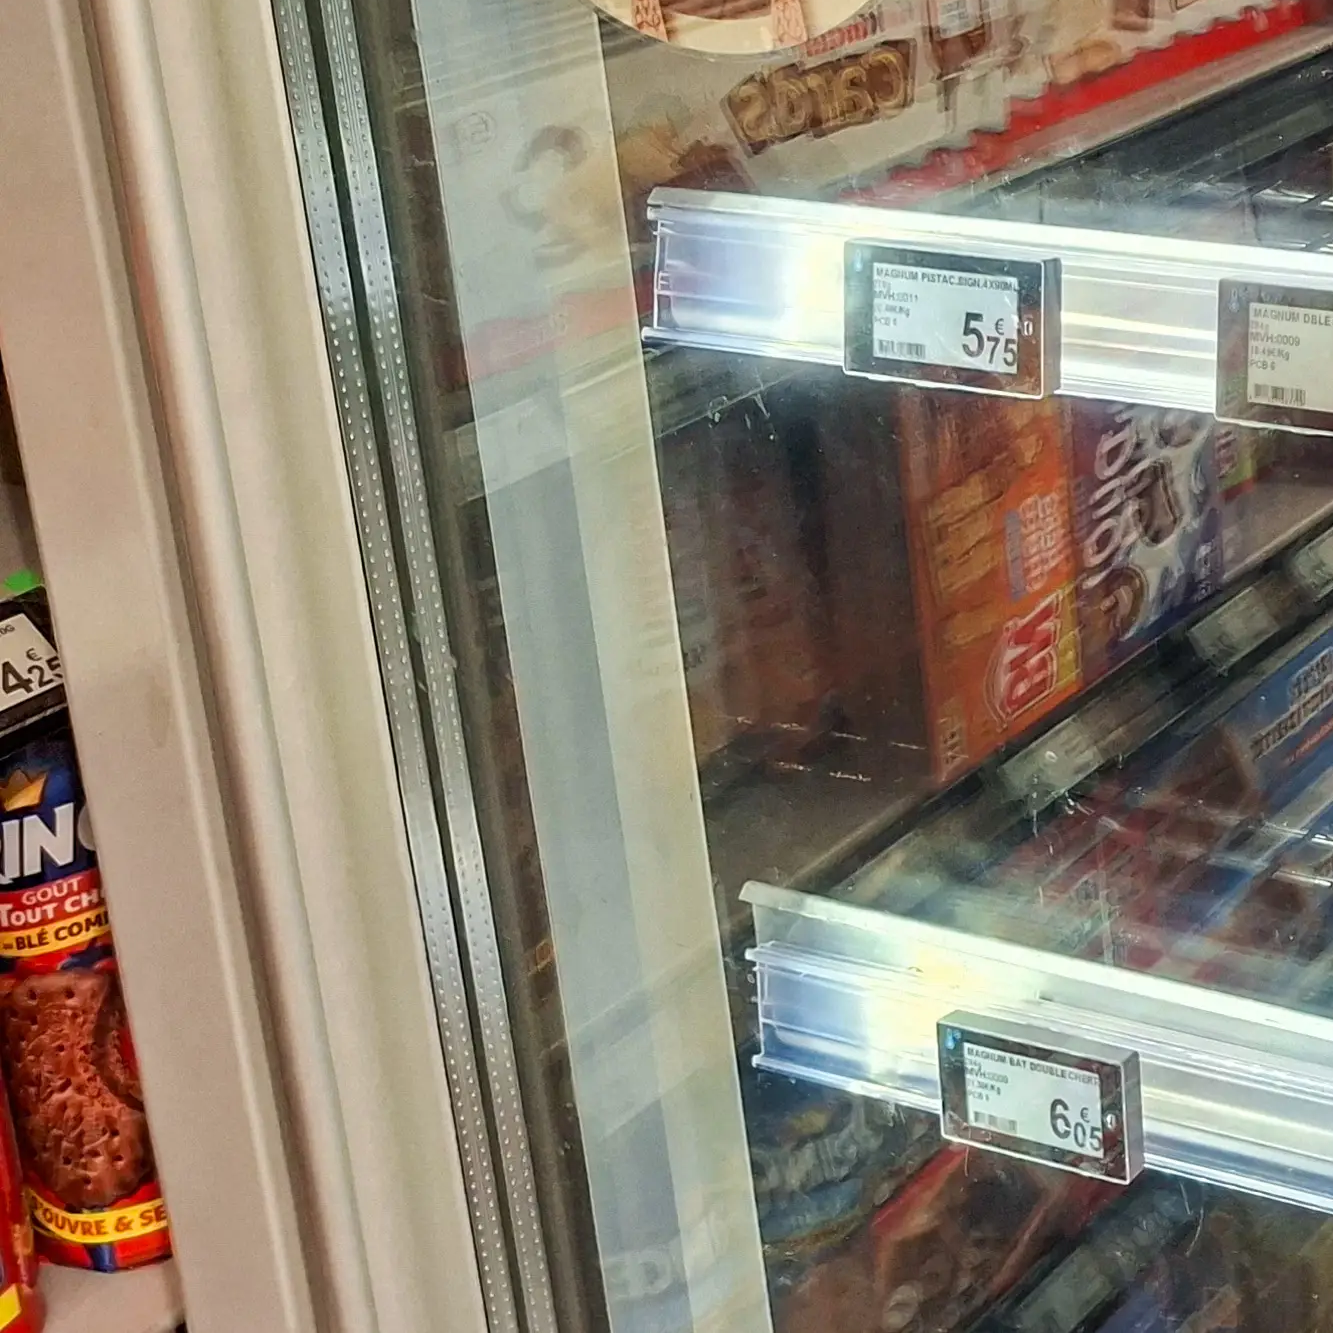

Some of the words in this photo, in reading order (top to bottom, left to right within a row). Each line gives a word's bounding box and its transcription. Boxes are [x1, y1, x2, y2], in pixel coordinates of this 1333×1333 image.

[1254, 307, 1301, 323] MAGNUM
[1303, 313, 1331, 327] DBLE
[962, 311, 984, 358] 5
[987, 336, 1018, 367] 75
[2, 661, 34, 695] 4
[64, 888, 103, 914] CH
[54, 910, 109, 942] COM
[1051, 1099, 1072, 1139] 6
[1073, 1122, 1103, 1151] 05
[114, 1216, 134, 1233] &
